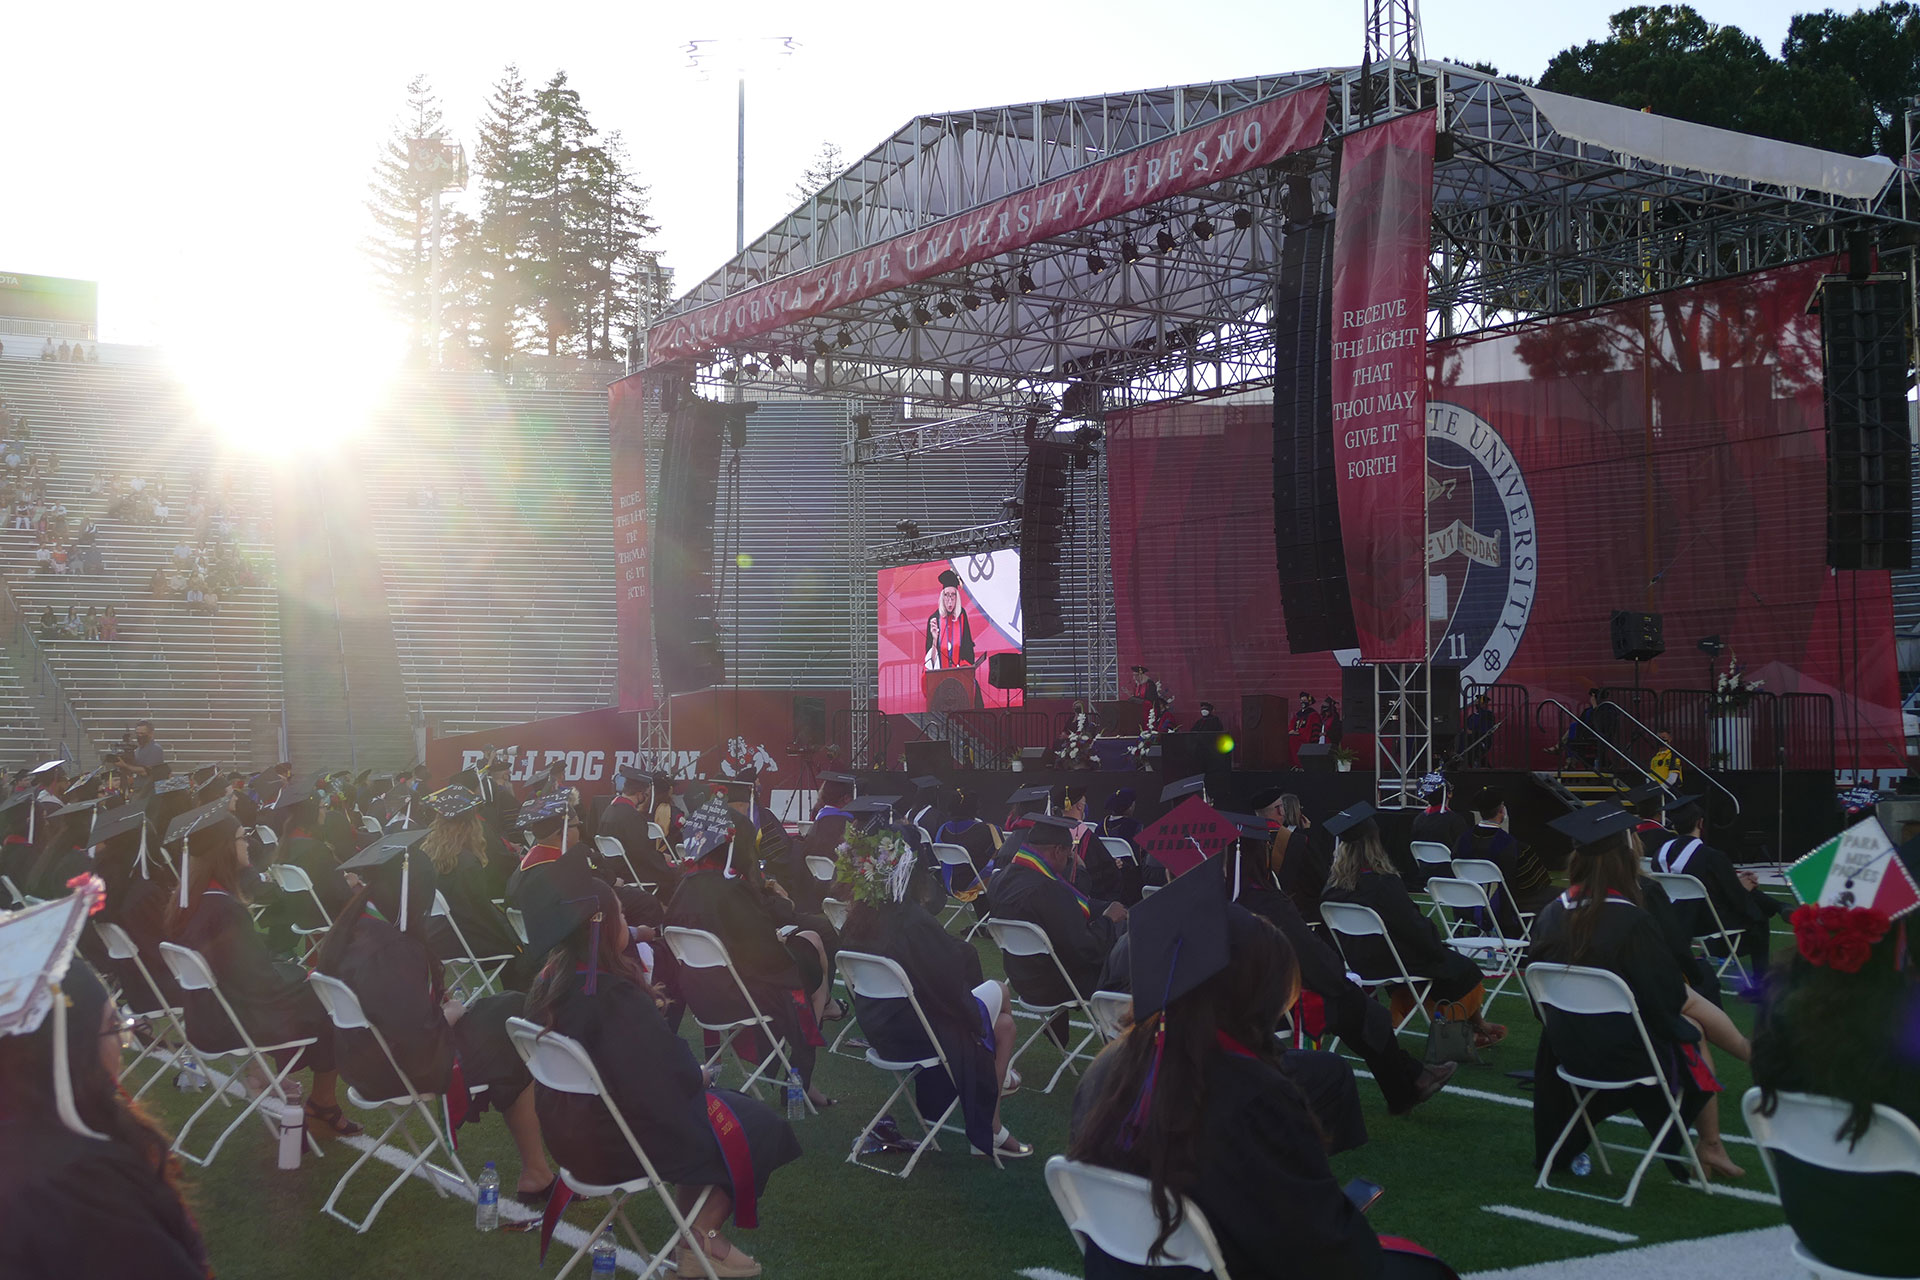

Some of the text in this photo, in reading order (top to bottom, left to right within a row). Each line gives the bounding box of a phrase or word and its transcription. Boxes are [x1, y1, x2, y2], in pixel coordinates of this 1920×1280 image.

[674, 286, 803, 348] CALIFORNIA
[816, 252, 891, 301] STATE
[1123, 121, 1263, 197] FRESNO
[1342, 299, 1407, 329] RECEIVE
[1333, 328, 1420, 361] THE LIGHT
[1353, 362, 1393, 387] THAT
[1333, 390, 1416, 421] THOU MAY
[1345, 423, 1400, 449] GIVE IT
[1347, 455, 1397, 480] FORTH
[1458, 527, 1499, 563] REDDAS
[1469, 424, 1533, 644] UNIVERSITY
[462, 750, 605, 781] BLLDOG
[1158, 822, 1217, 835] MAKING
[1843, 835, 1880, 850] PARA
[1146, 838, 1228, 850] HEADLNES
[1845, 852, 1873, 866] MIS
